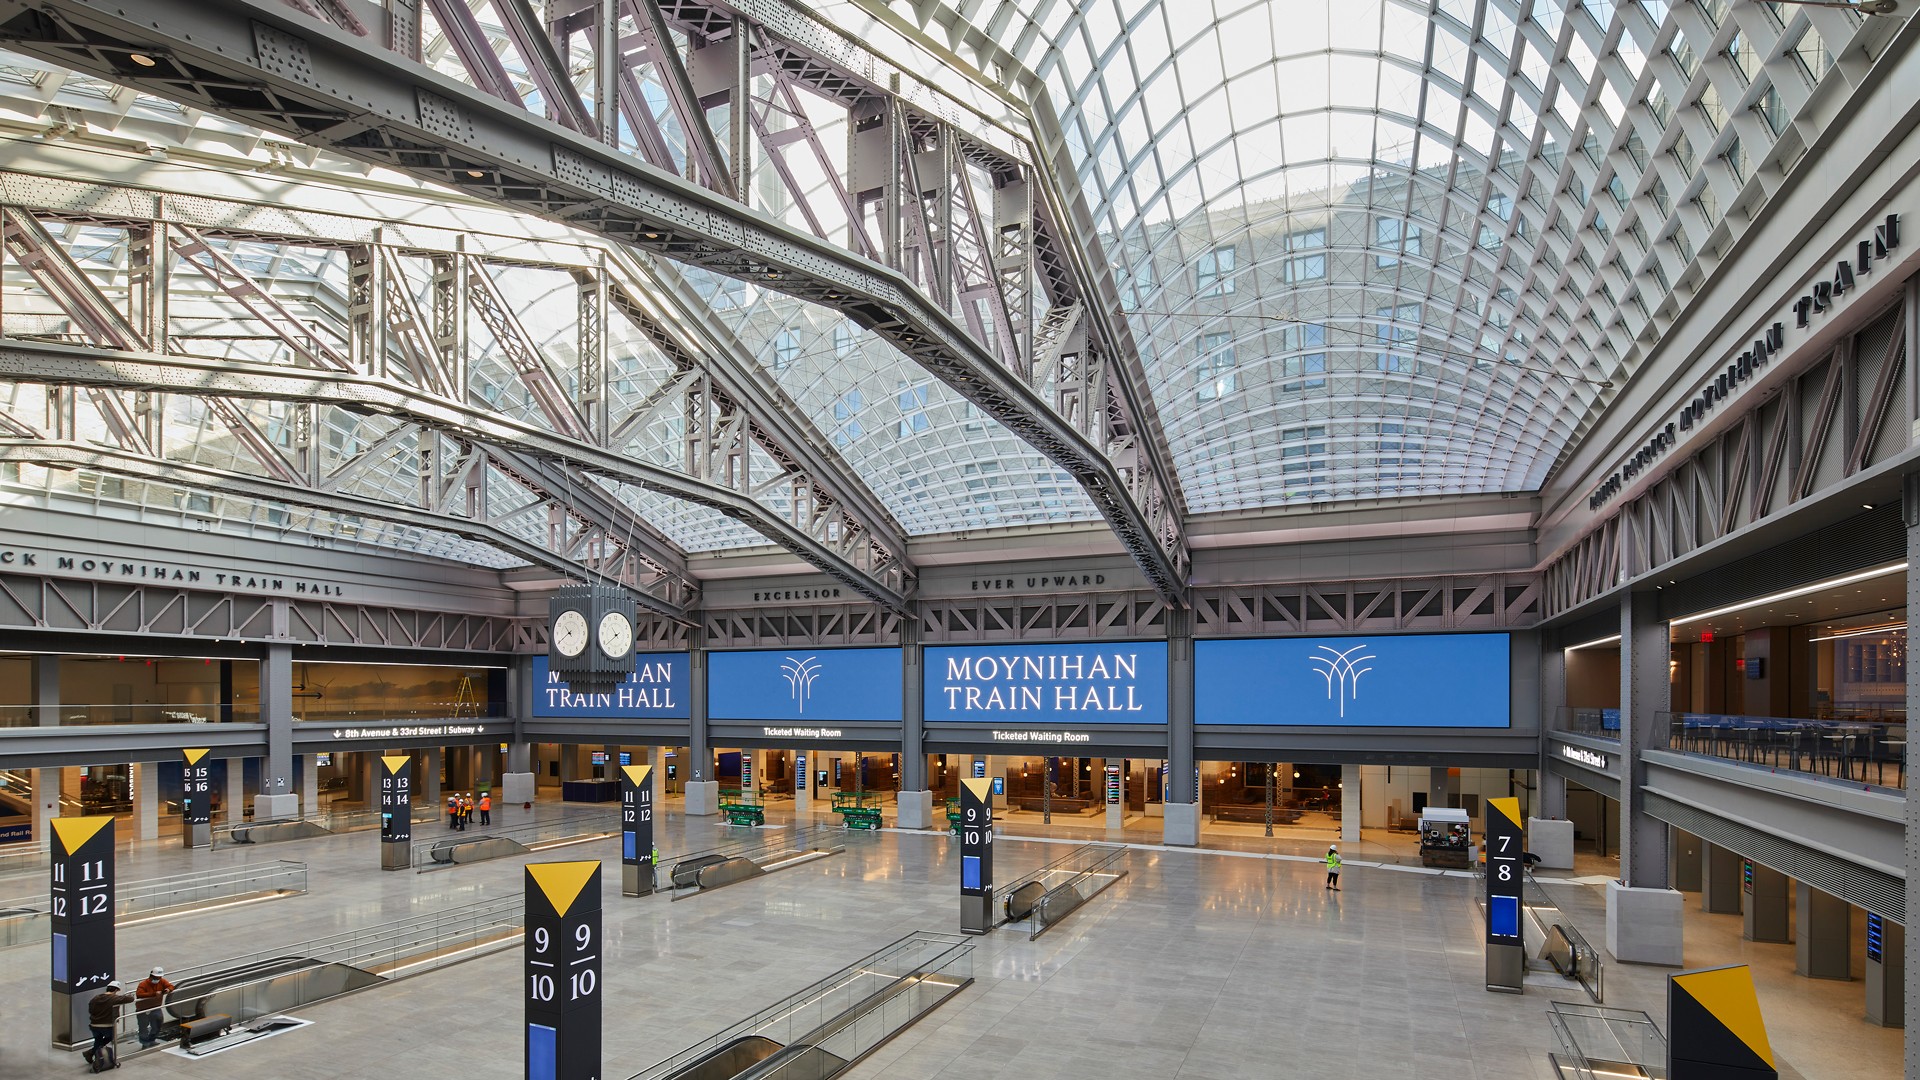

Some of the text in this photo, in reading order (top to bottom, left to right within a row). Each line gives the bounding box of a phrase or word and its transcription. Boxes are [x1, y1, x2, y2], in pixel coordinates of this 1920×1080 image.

[1680, 322, 1783, 432] MOYNIHAN
[1793, 214, 1899, 329] TRAIN
[58, 556, 200, 582] MOYNIHAN
[216, 574, 282, 590] TRAIN
[296, 582, 342, 596] HALL
[972, 574, 1106, 590] EVER UPWARD
[754, 588, 840, 602] EXCELSIOR
[946, 654, 1137, 680] MOYNIHAN
[546, 688, 676, 708] TRAIN HALL
[944, 686, 1143, 710] TRAIN HALL
[345, 729, 359, 738] 8th
[361, 729, 390, 737] Avenue
[392, 728, 398, 736] &
[400, 728, 417, 736] 33rd
[419, 726, 441, 735] Street
[448, 726, 475, 735] Subway
[764, 727, 842, 738] Ticketed Waiting Room
[993, 731, 1090, 742] Ticketed Waiting Room
[184, 768, 190, 777] 15
[196, 768, 208, 777] 15
[184, 783, 191, 792] 16
[196, 782, 208, 792] 16
[383, 778, 391, 788] 13
[397, 777, 408, 788] 13
[383, 795, 392, 805] 14
[397, 794, 408, 805] 14
[625, 791, 633, 803] 11
[641, 790, 650, 802] 11
[624, 810, 635, 822] 12
[640, 809, 651, 822] 12
[967, 808, 976, 822] 9
[986, 807, 991, 821] 9
[964, 831, 979, 845] 10
[985, 830, 992, 845] 10
[1498, 836, 1511, 852] 7
[54, 862, 65, 883] 11
[82, 860, 105, 882] 11
[1498, 864, 1511, 881] 8
[54, 896, 66, 917] 12
[80, 893, 107, 916] 12
[534, 927, 550, 954] 9
[575, 924, 591, 951] 9
[530, 974, 555, 1002] 10
[570, 968, 596, 1001] 10
